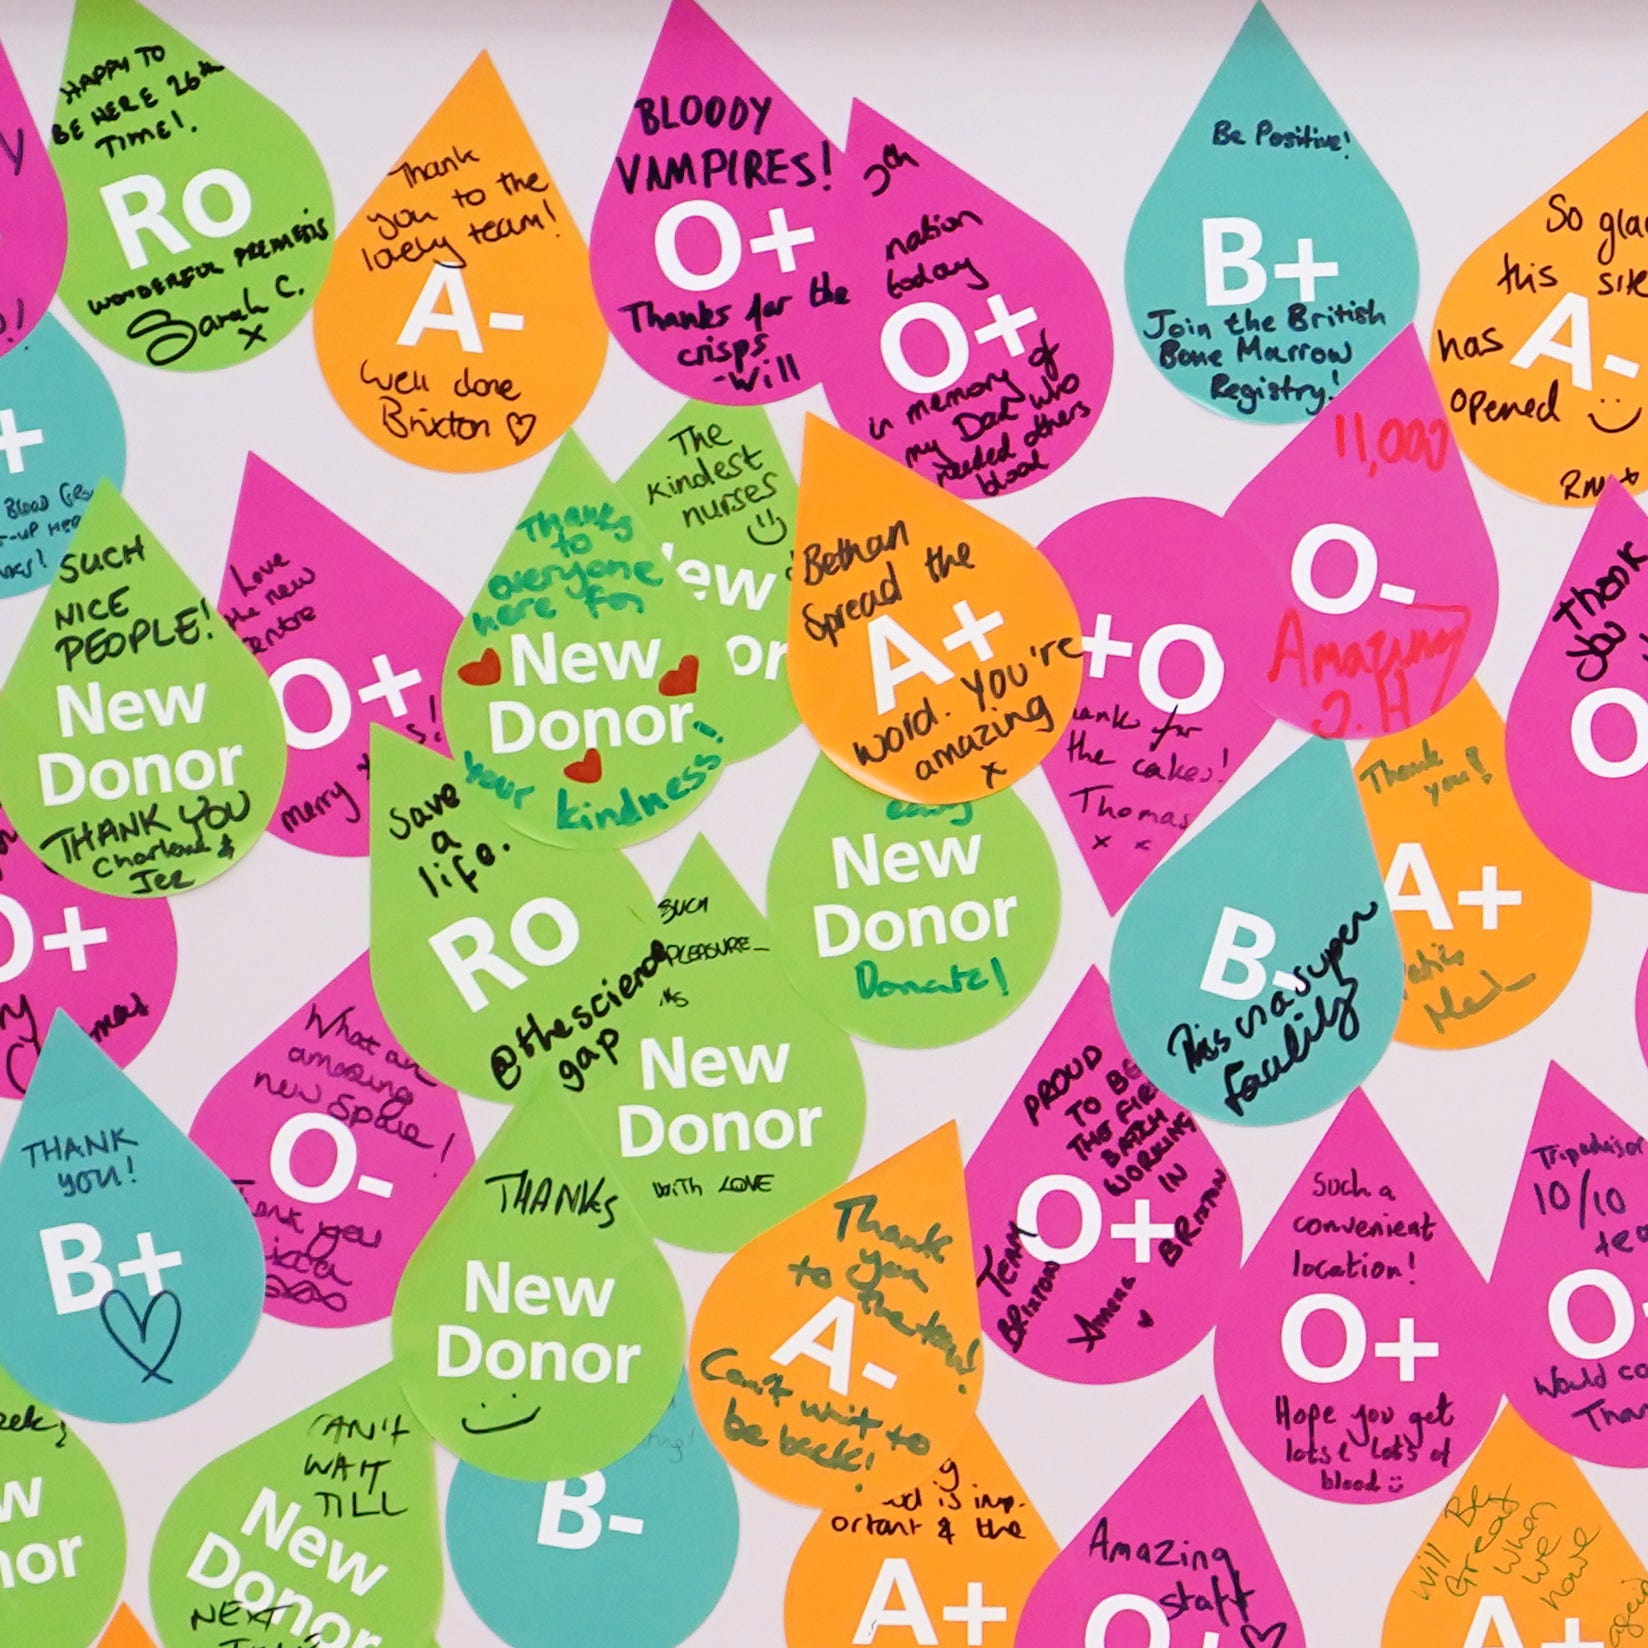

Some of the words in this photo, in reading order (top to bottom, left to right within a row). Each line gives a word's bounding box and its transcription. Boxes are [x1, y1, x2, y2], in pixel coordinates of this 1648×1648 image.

[135, 45, 166, 65] TO
[636, 95, 772, 135] BLOODY
[1212, 121, 1245, 149] Be
[1253, 123, 1353, 158] Positive!
[616, 150, 835, 194] VAMPIRES!
[98, 167, 252, 270] Ro
[1545, 197, 1583, 232] So
[654, 199, 816, 291] O+
[1200, 218, 1339, 307] B+
[395, 262, 525, 354] A-
[1142, 308, 1211, 342] Join
[1224, 307, 1278, 336] the
[1287, 299, 1386, 330] British
[1158, 340, 1228, 369] Bone
[1236, 340, 1352, 370] Marrow
[1510, 292, 1640, 391] A-
[454, 369, 521, 402] done
[1209, 377, 1341, 415] Registry!
[378, 397, 490, 440] Brixton
[1290, 523, 1416, 615] O-
[55, 589, 131, 630] NICE
[55, 602, 213, 673] PEOPLE!
[55, 681, 207, 739] New
[915, 694, 1057, 783] amazing
[37, 744, 244, 808] Donor
[428, 894, 581, 1015] Ro
[640, 1037, 792, 1092] New
[1022, 1043, 1103, 1126] PROUD
[22, 1127, 141, 1168] THANK
[619, 1105, 824, 1160] Donor
[1292, 1214, 1436, 1244] convenient
[1533, 1180, 1627, 1233] 10/10
[464, 1261, 616, 1318] New
[1292, 1251, 1417, 1286] location!
[436, 1325, 641, 1386] Donor
[1280, 1292, 1439, 1385] O+
[1275, 1396, 1338, 1437] Hope
[1088, 1521, 1238, 1588] Amazing
